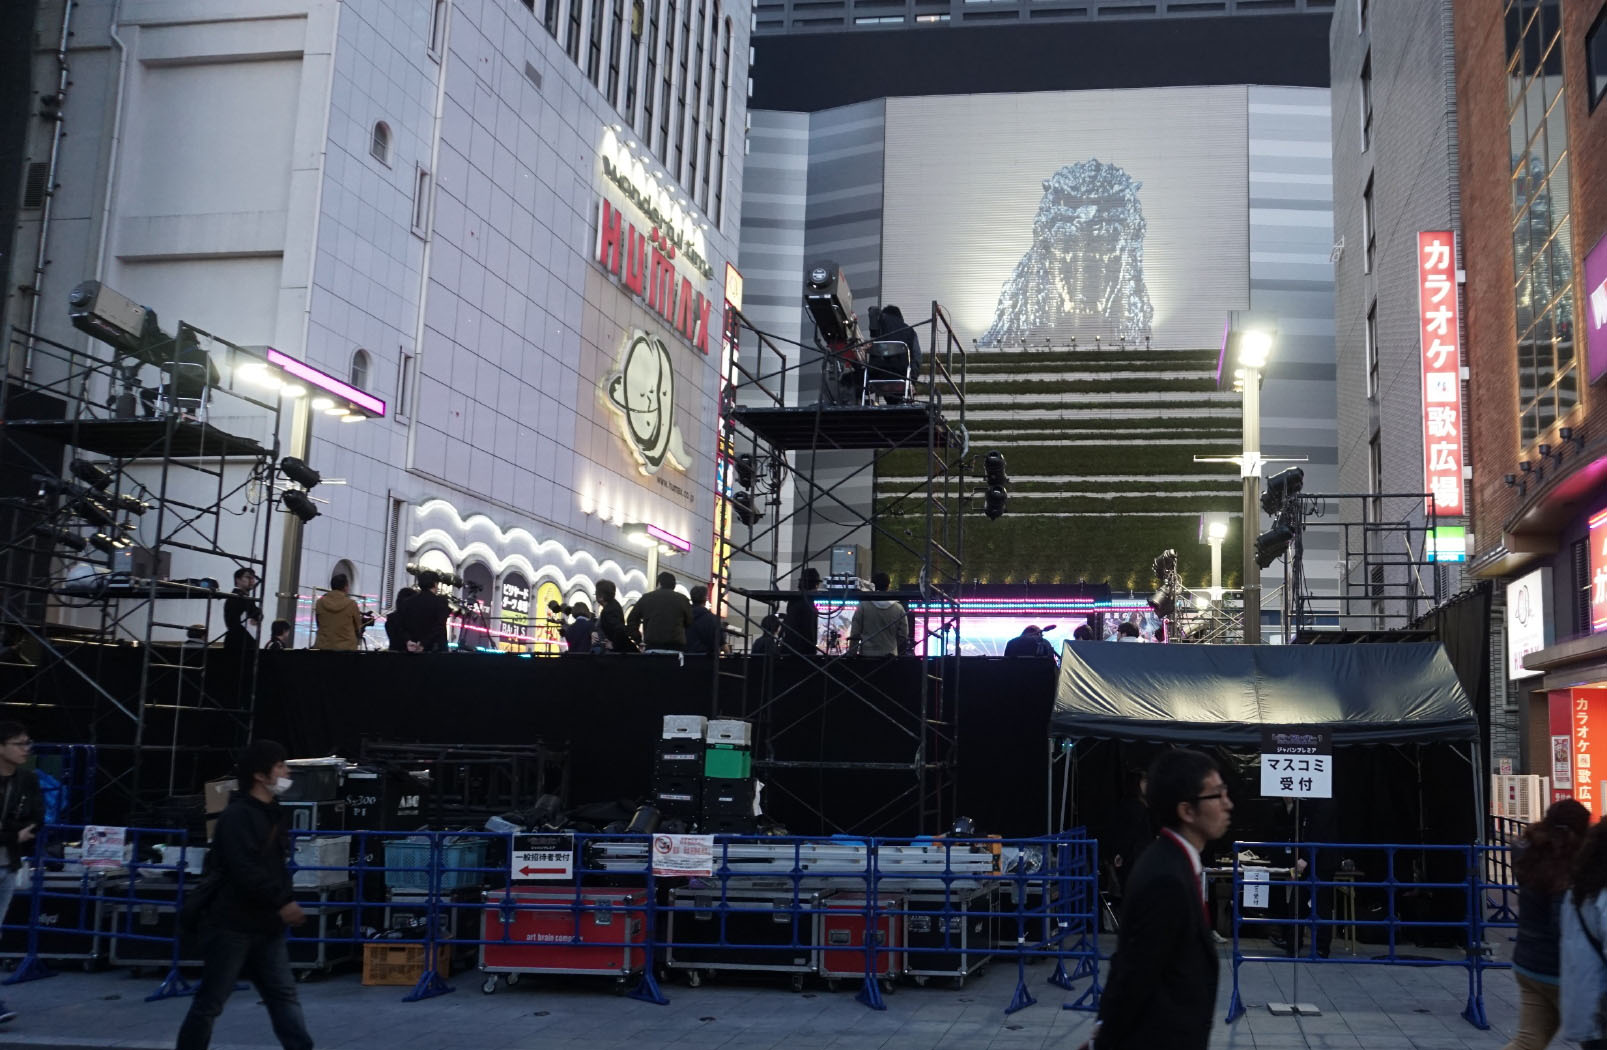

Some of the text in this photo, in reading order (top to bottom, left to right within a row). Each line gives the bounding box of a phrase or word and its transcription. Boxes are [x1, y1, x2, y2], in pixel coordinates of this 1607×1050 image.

[598, 197, 712, 355] HUMAX
[1424, 239, 1460, 508] カラオケ 歌広場
[1576, 697, 1590, 752] カラオケ
[1267, 758, 1325, 773] マスコミ
[1280, 776, 1313, 792] 受付
[526, 933, 537, 942] art
